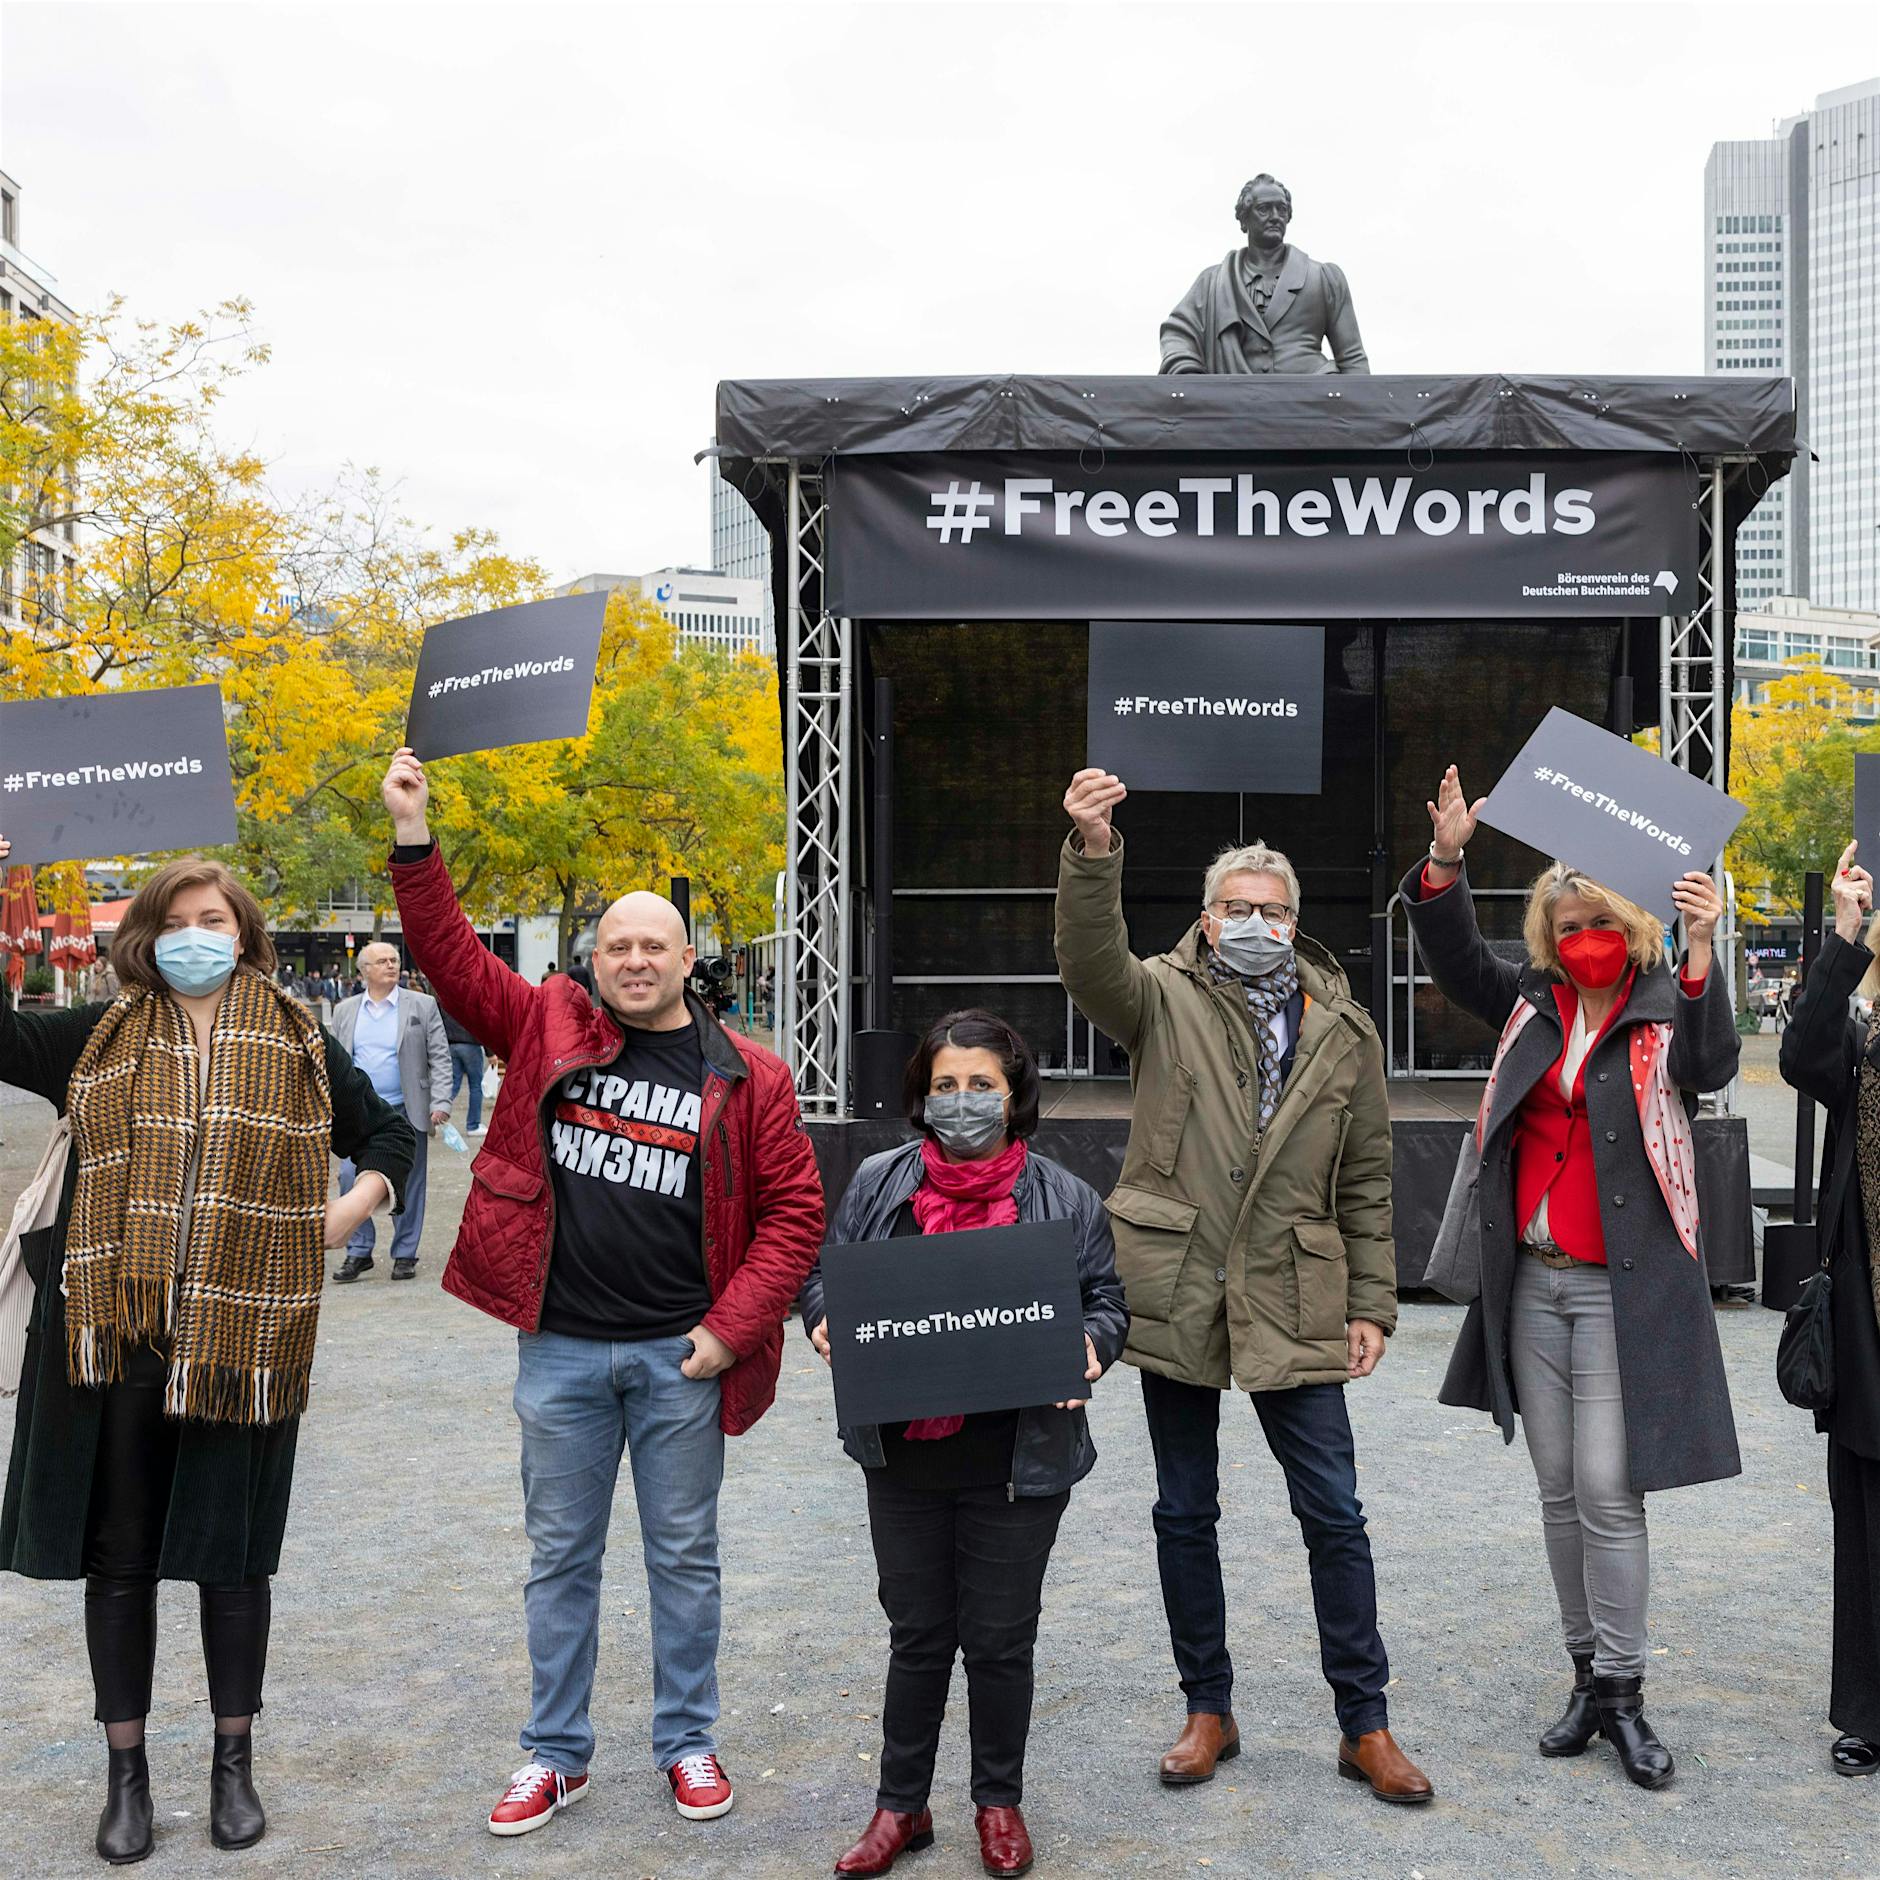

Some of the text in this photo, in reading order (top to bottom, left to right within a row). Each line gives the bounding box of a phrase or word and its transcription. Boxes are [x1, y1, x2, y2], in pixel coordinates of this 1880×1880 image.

[926, 473, 1596, 544] #FreeTheWords
[1522, 585, 1650, 596] Deutschen Buchhandels
[1557, 572, 1650, 584] Börsenverein des
[428, 655, 575, 699] #FreeTheWords
[1113, 696, 1299, 718] #FreeTheWords
[3, 756, 203, 793] #FreeTheWords
[1533, 765, 1692, 857] #FreeTheWords
[562, 1068, 702, 1133] СТРАНА
[550, 1120, 690, 1199] ЖИЗНИ
[856, 1300, 1055, 1344] #FreeTheWords
